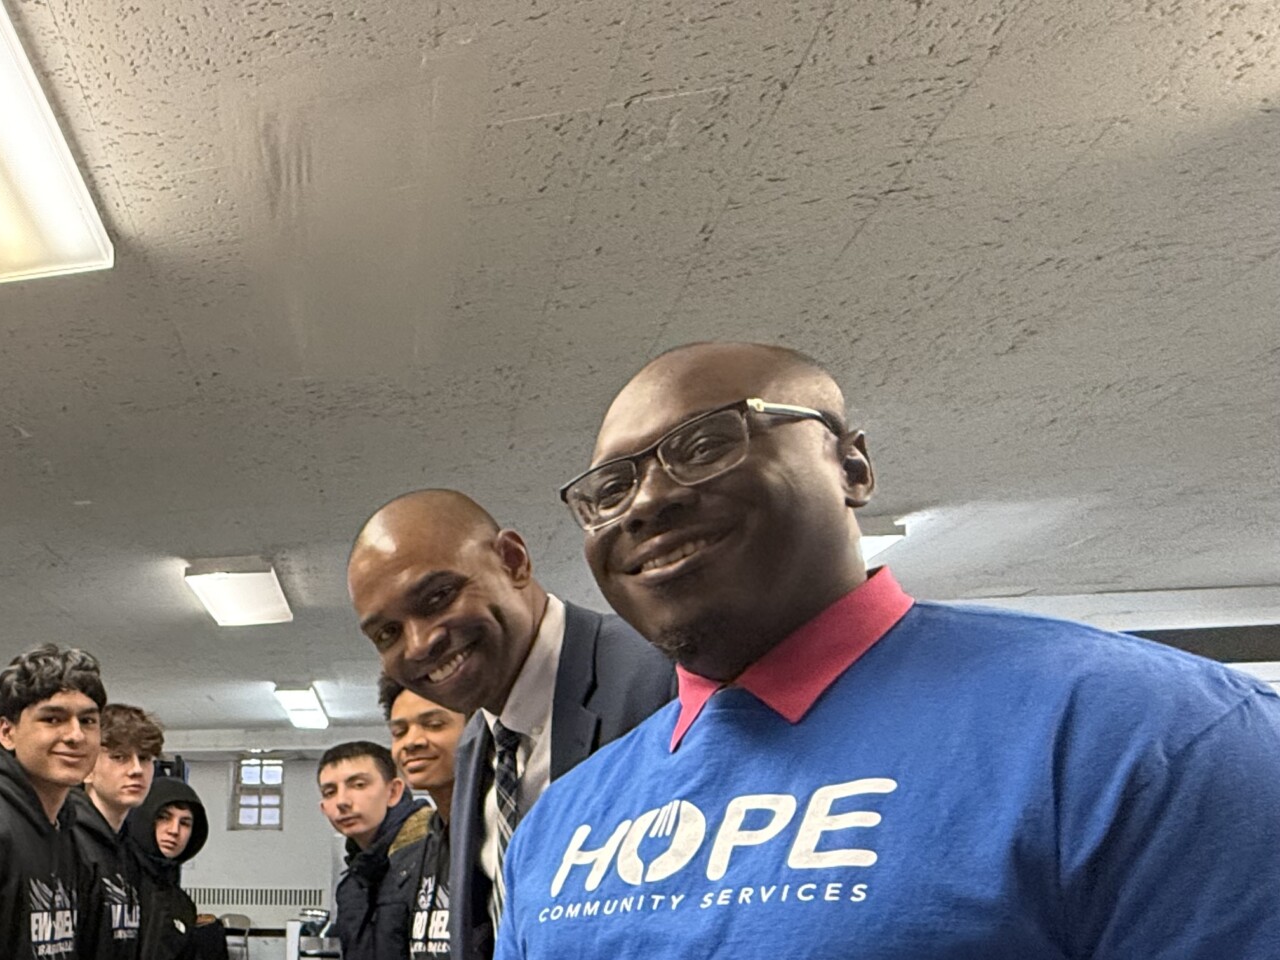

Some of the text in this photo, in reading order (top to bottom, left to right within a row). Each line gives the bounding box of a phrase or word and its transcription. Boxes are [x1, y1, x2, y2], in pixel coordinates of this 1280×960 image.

[550, 778, 898, 897] HOPE
[538, 882, 869, 923] COMMUNITY SERVICES
